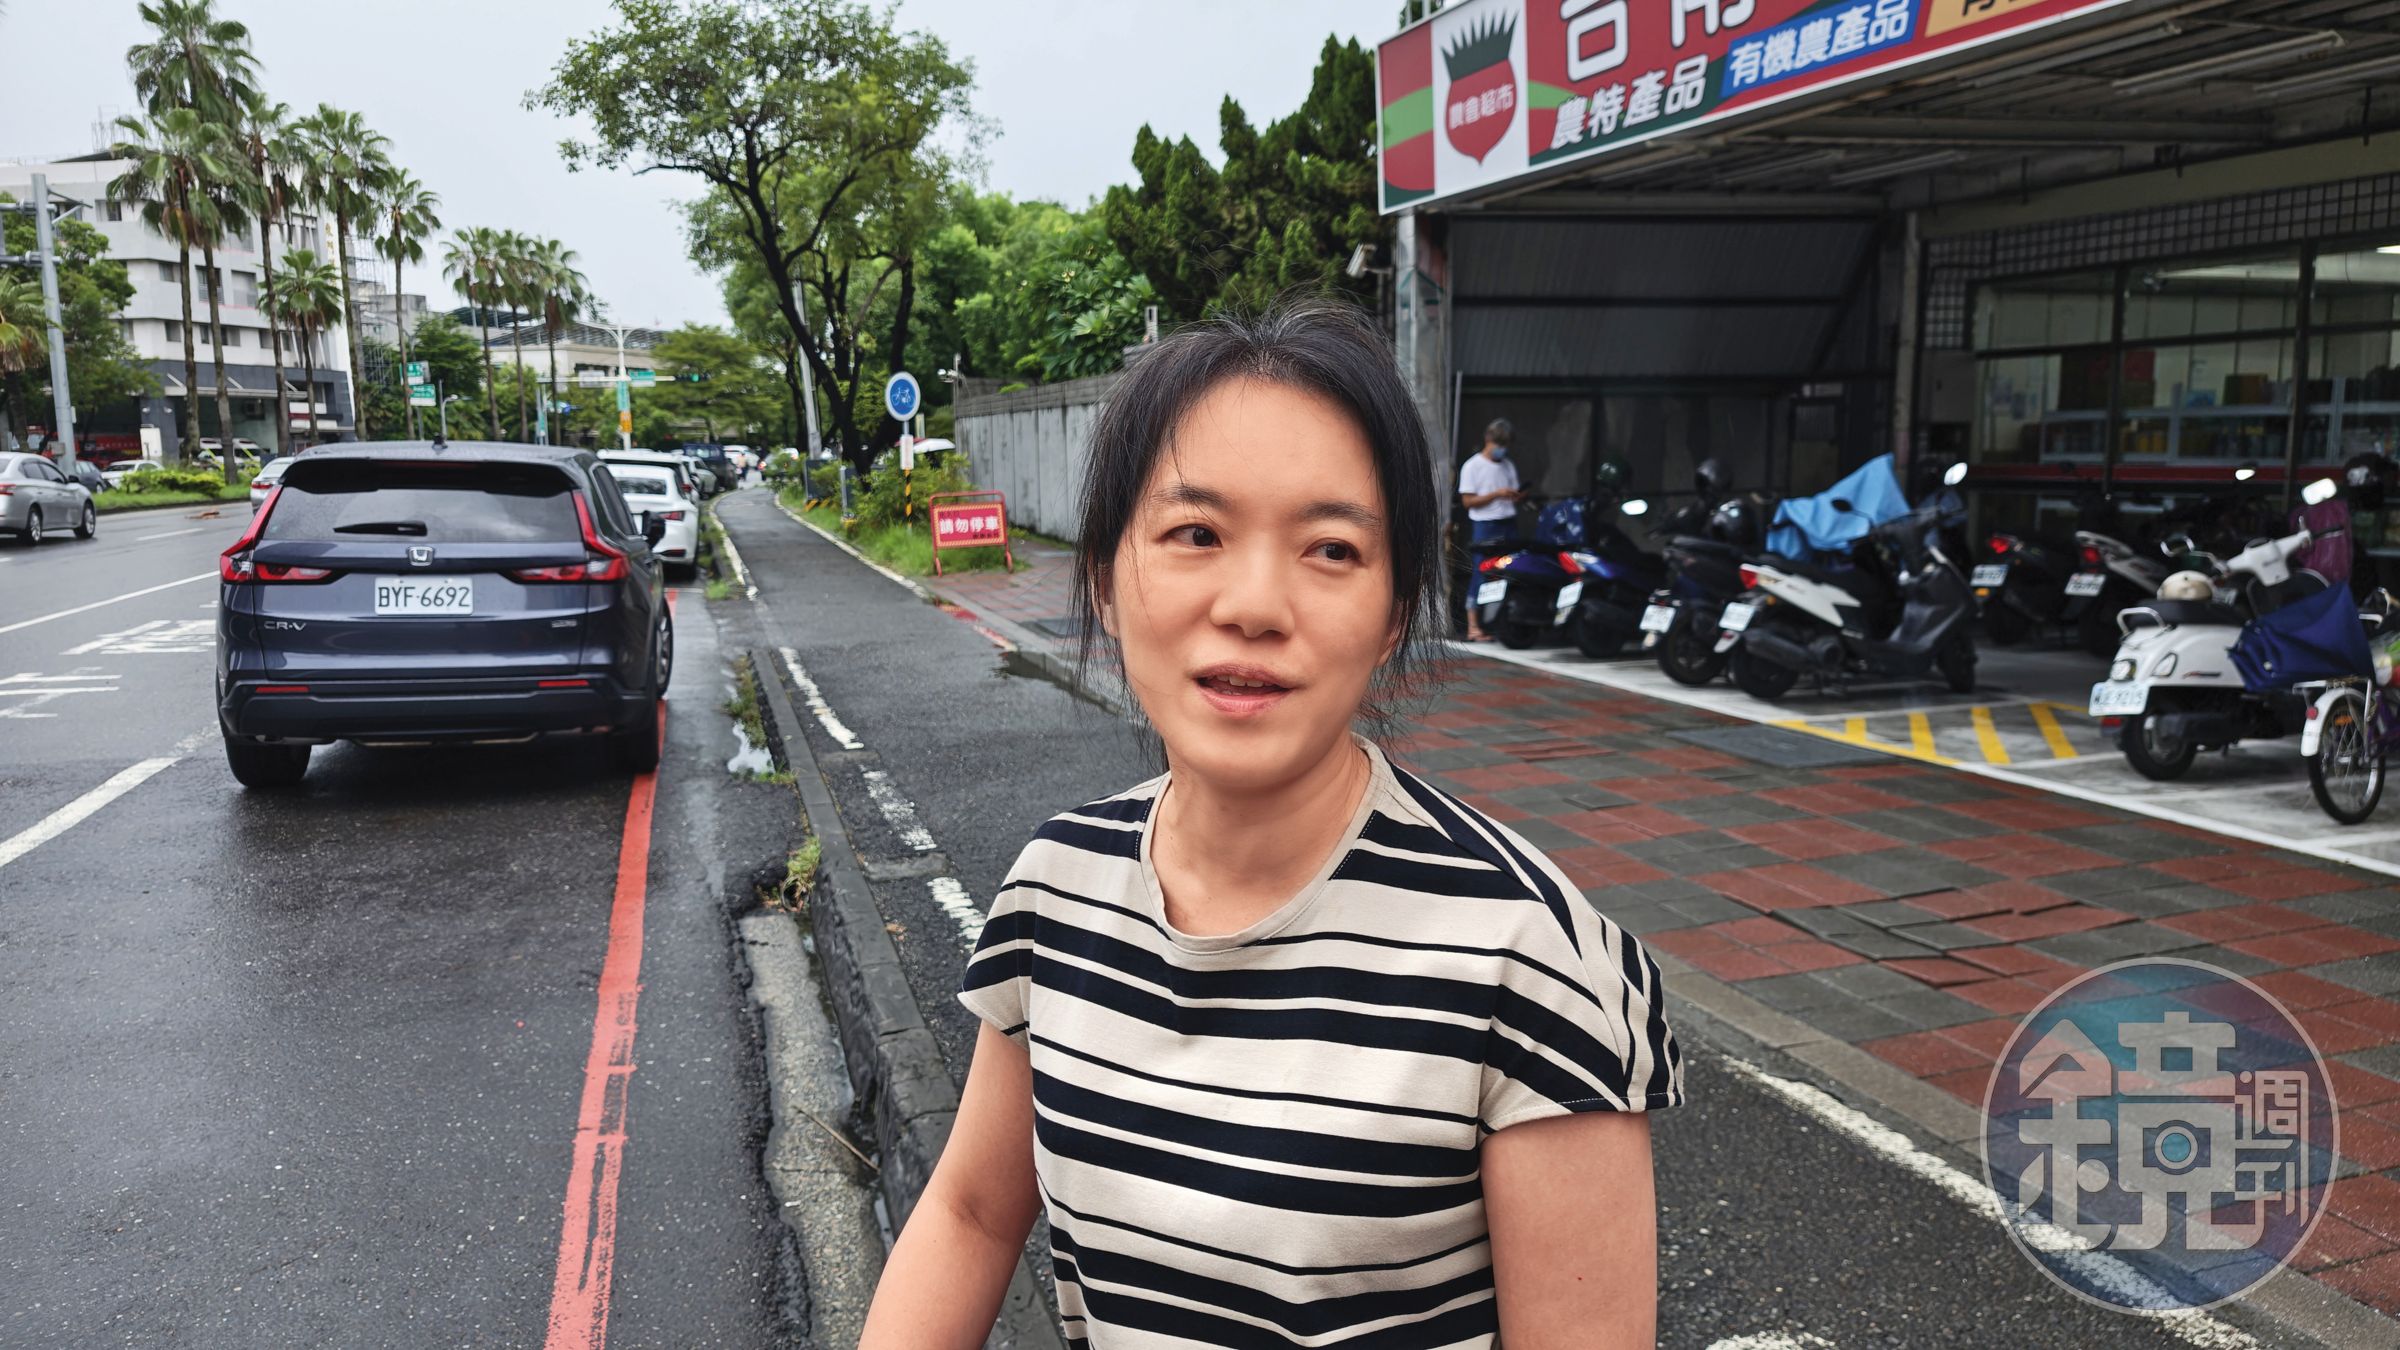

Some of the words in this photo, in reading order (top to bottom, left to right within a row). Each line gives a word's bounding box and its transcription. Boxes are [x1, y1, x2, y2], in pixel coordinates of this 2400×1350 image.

[1729, 0, 1910, 87] 有機農產品
[1449, 83, 1514, 130] 農會超市
[1551, 53, 1709, 149] 農特產品
[940, 515, 998, 535] 請勿停車
[377, 586, 470, 608] BYF-6692
